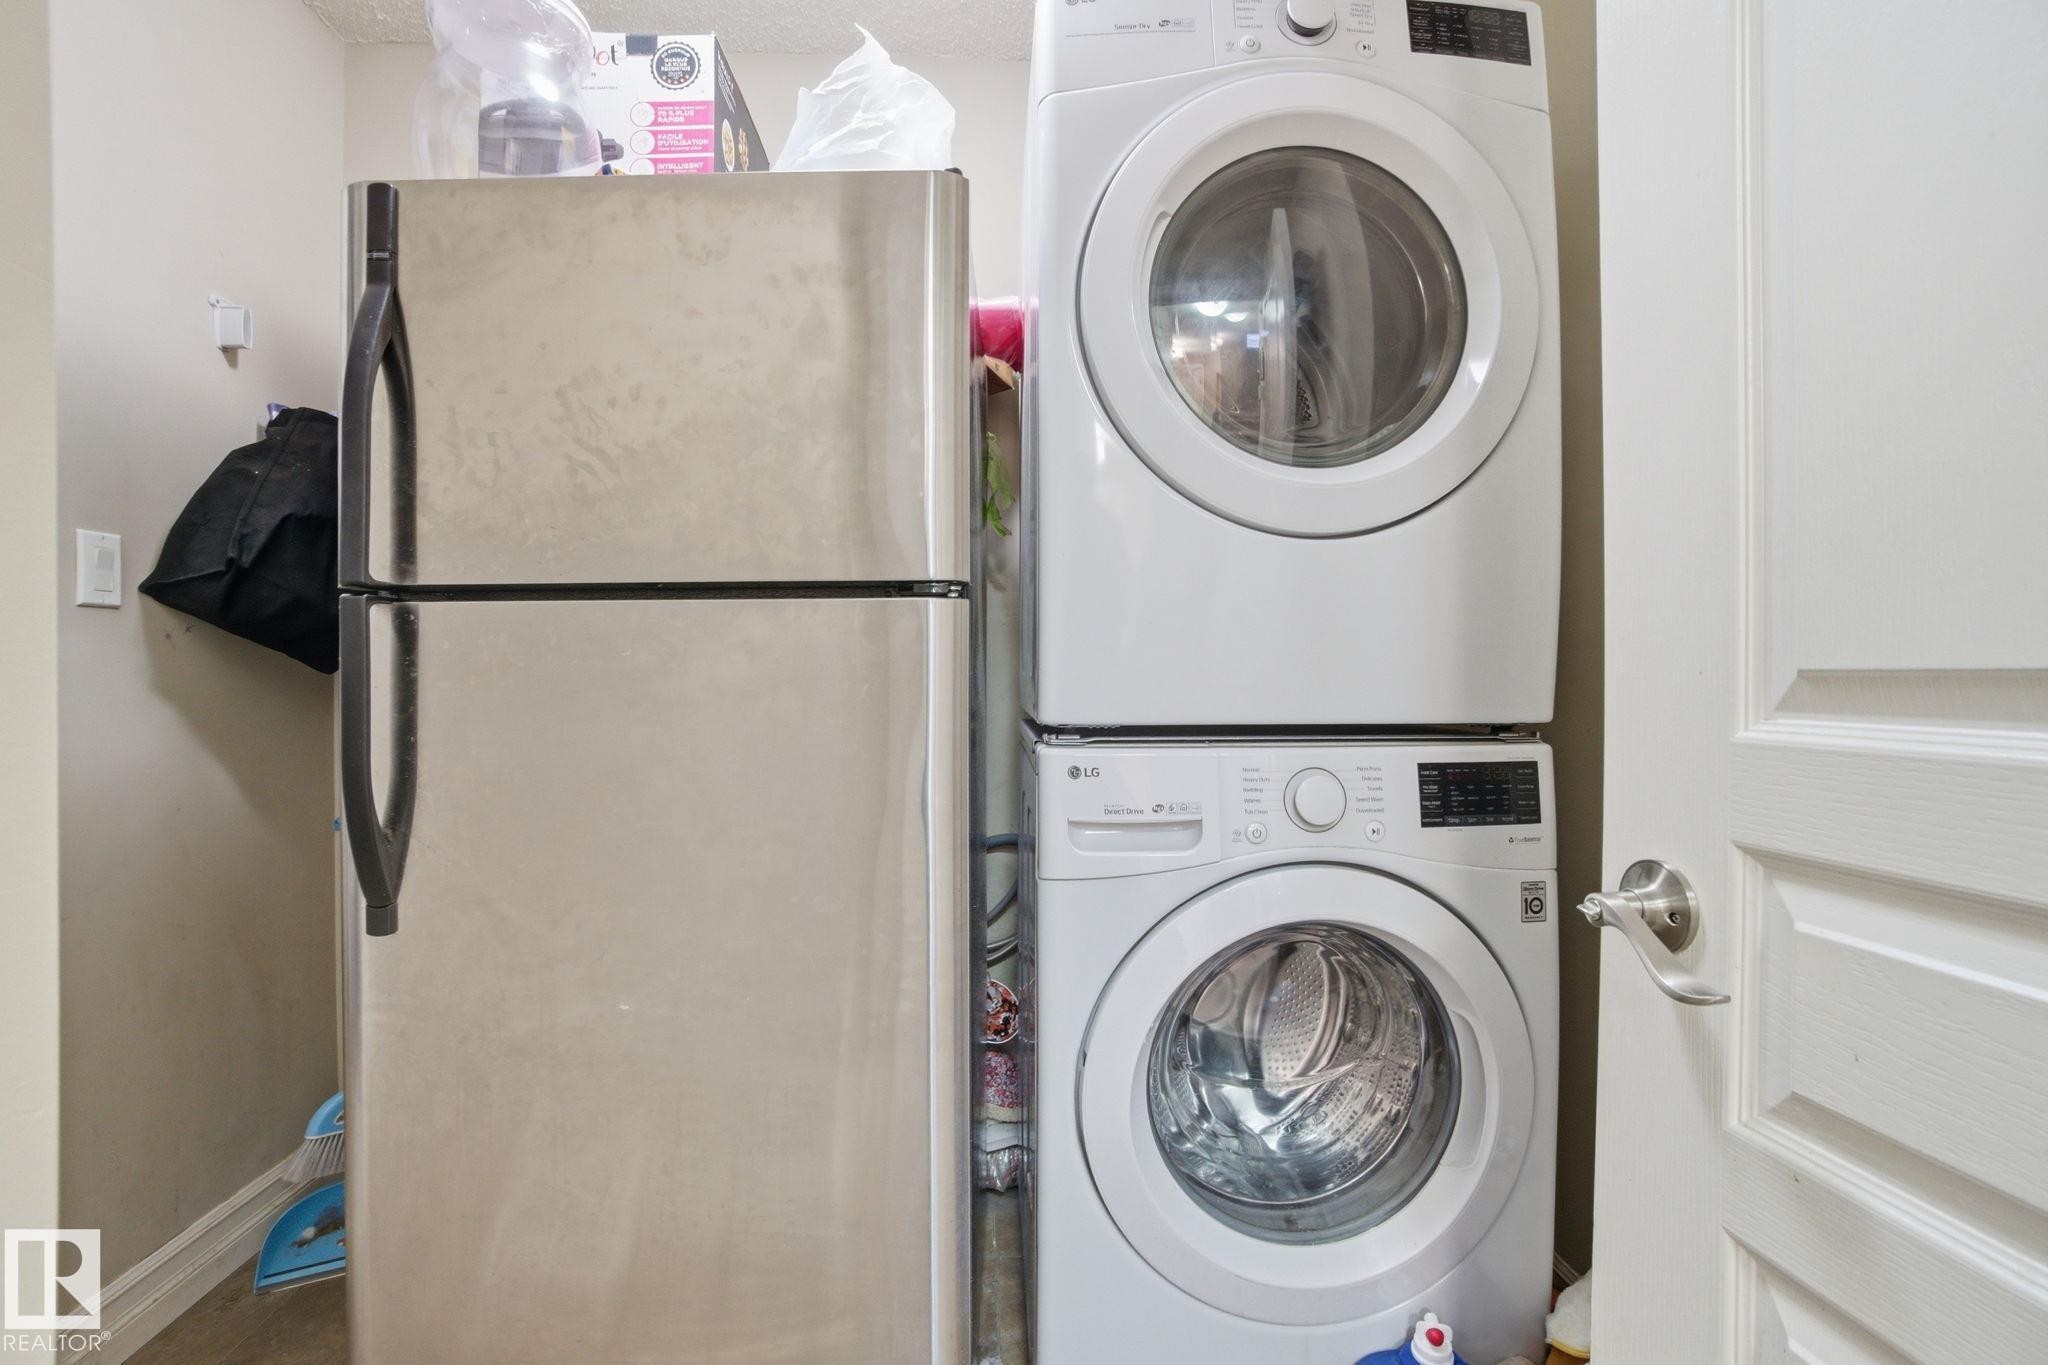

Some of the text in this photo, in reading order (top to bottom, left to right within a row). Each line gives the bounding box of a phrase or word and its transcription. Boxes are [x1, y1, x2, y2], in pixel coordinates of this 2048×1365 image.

[675, 109, 695, 117] PLUS
[657, 162, 704, 170] INTELLIGENT
[1084, 767, 1100, 778] LG
[1524, 896, 1543, 915] 10
